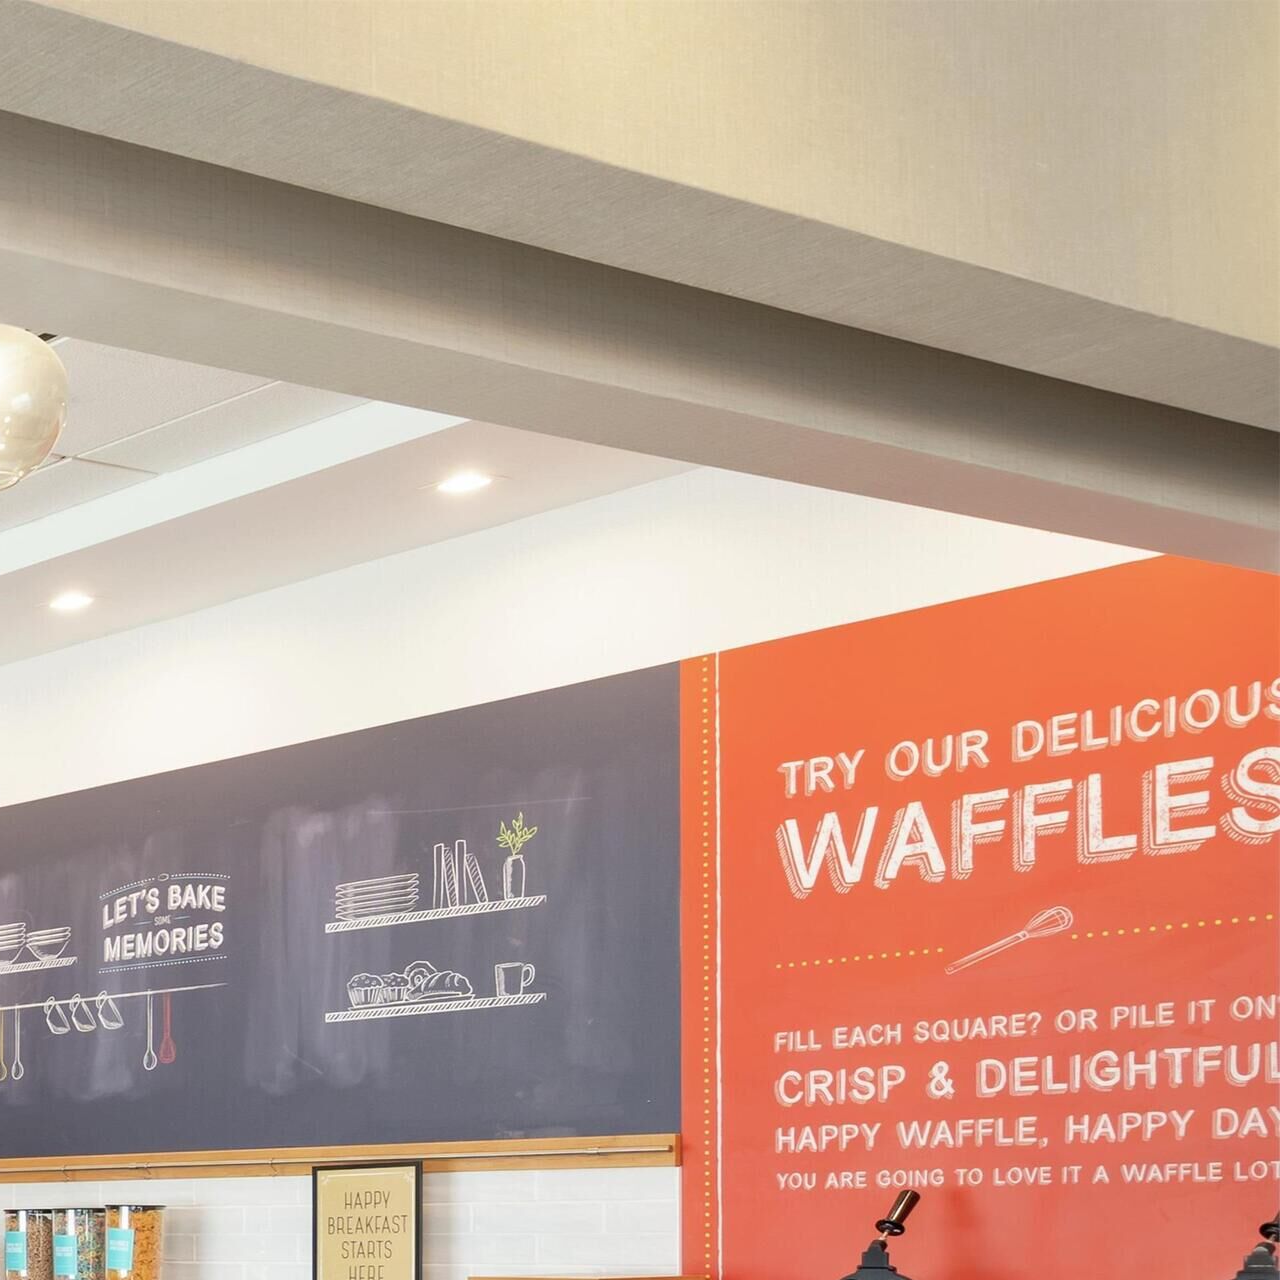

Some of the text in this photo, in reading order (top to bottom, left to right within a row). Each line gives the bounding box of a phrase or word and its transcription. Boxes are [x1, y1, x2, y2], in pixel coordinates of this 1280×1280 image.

[777, 749, 865, 798] TRY
[885, 729, 989, 781] OUR
[776, 746, 1280, 899] WAFFLES
[102, 884, 226, 930] LET'S BAKE
[103, 922, 224, 962] MEMORIES
[774, 994, 1280, 1053] FILL EACH SQUARE? OR PILE IT ON
[774, 1065, 907, 1107] CRISP
[926, 1060, 955, 1099] &
[775, 1122, 881, 1153] HAPPY
[896, 1116, 1049, 1150] WAFFLE,
[1065, 1110, 1195, 1144] HAPPY
[777, 1172, 817, 1191] YOU
[825, 1171, 868, 1190] ARE
[876, 1168, 945, 1189] GOING
[955, 1167, 984, 1186] TO
[993, 1165, 1052, 1187] LOVE
[1062, 1165, 1082, 1184] IT
[1092, 1164, 1110, 1184] A
[1120, 1162, 1223, 1184] WAFFLE
[344, 1190, 390, 1210] HAPPY
[327, 1214, 408, 1235] BREAKFAST
[341, 1240, 393, 1259] STARTS
